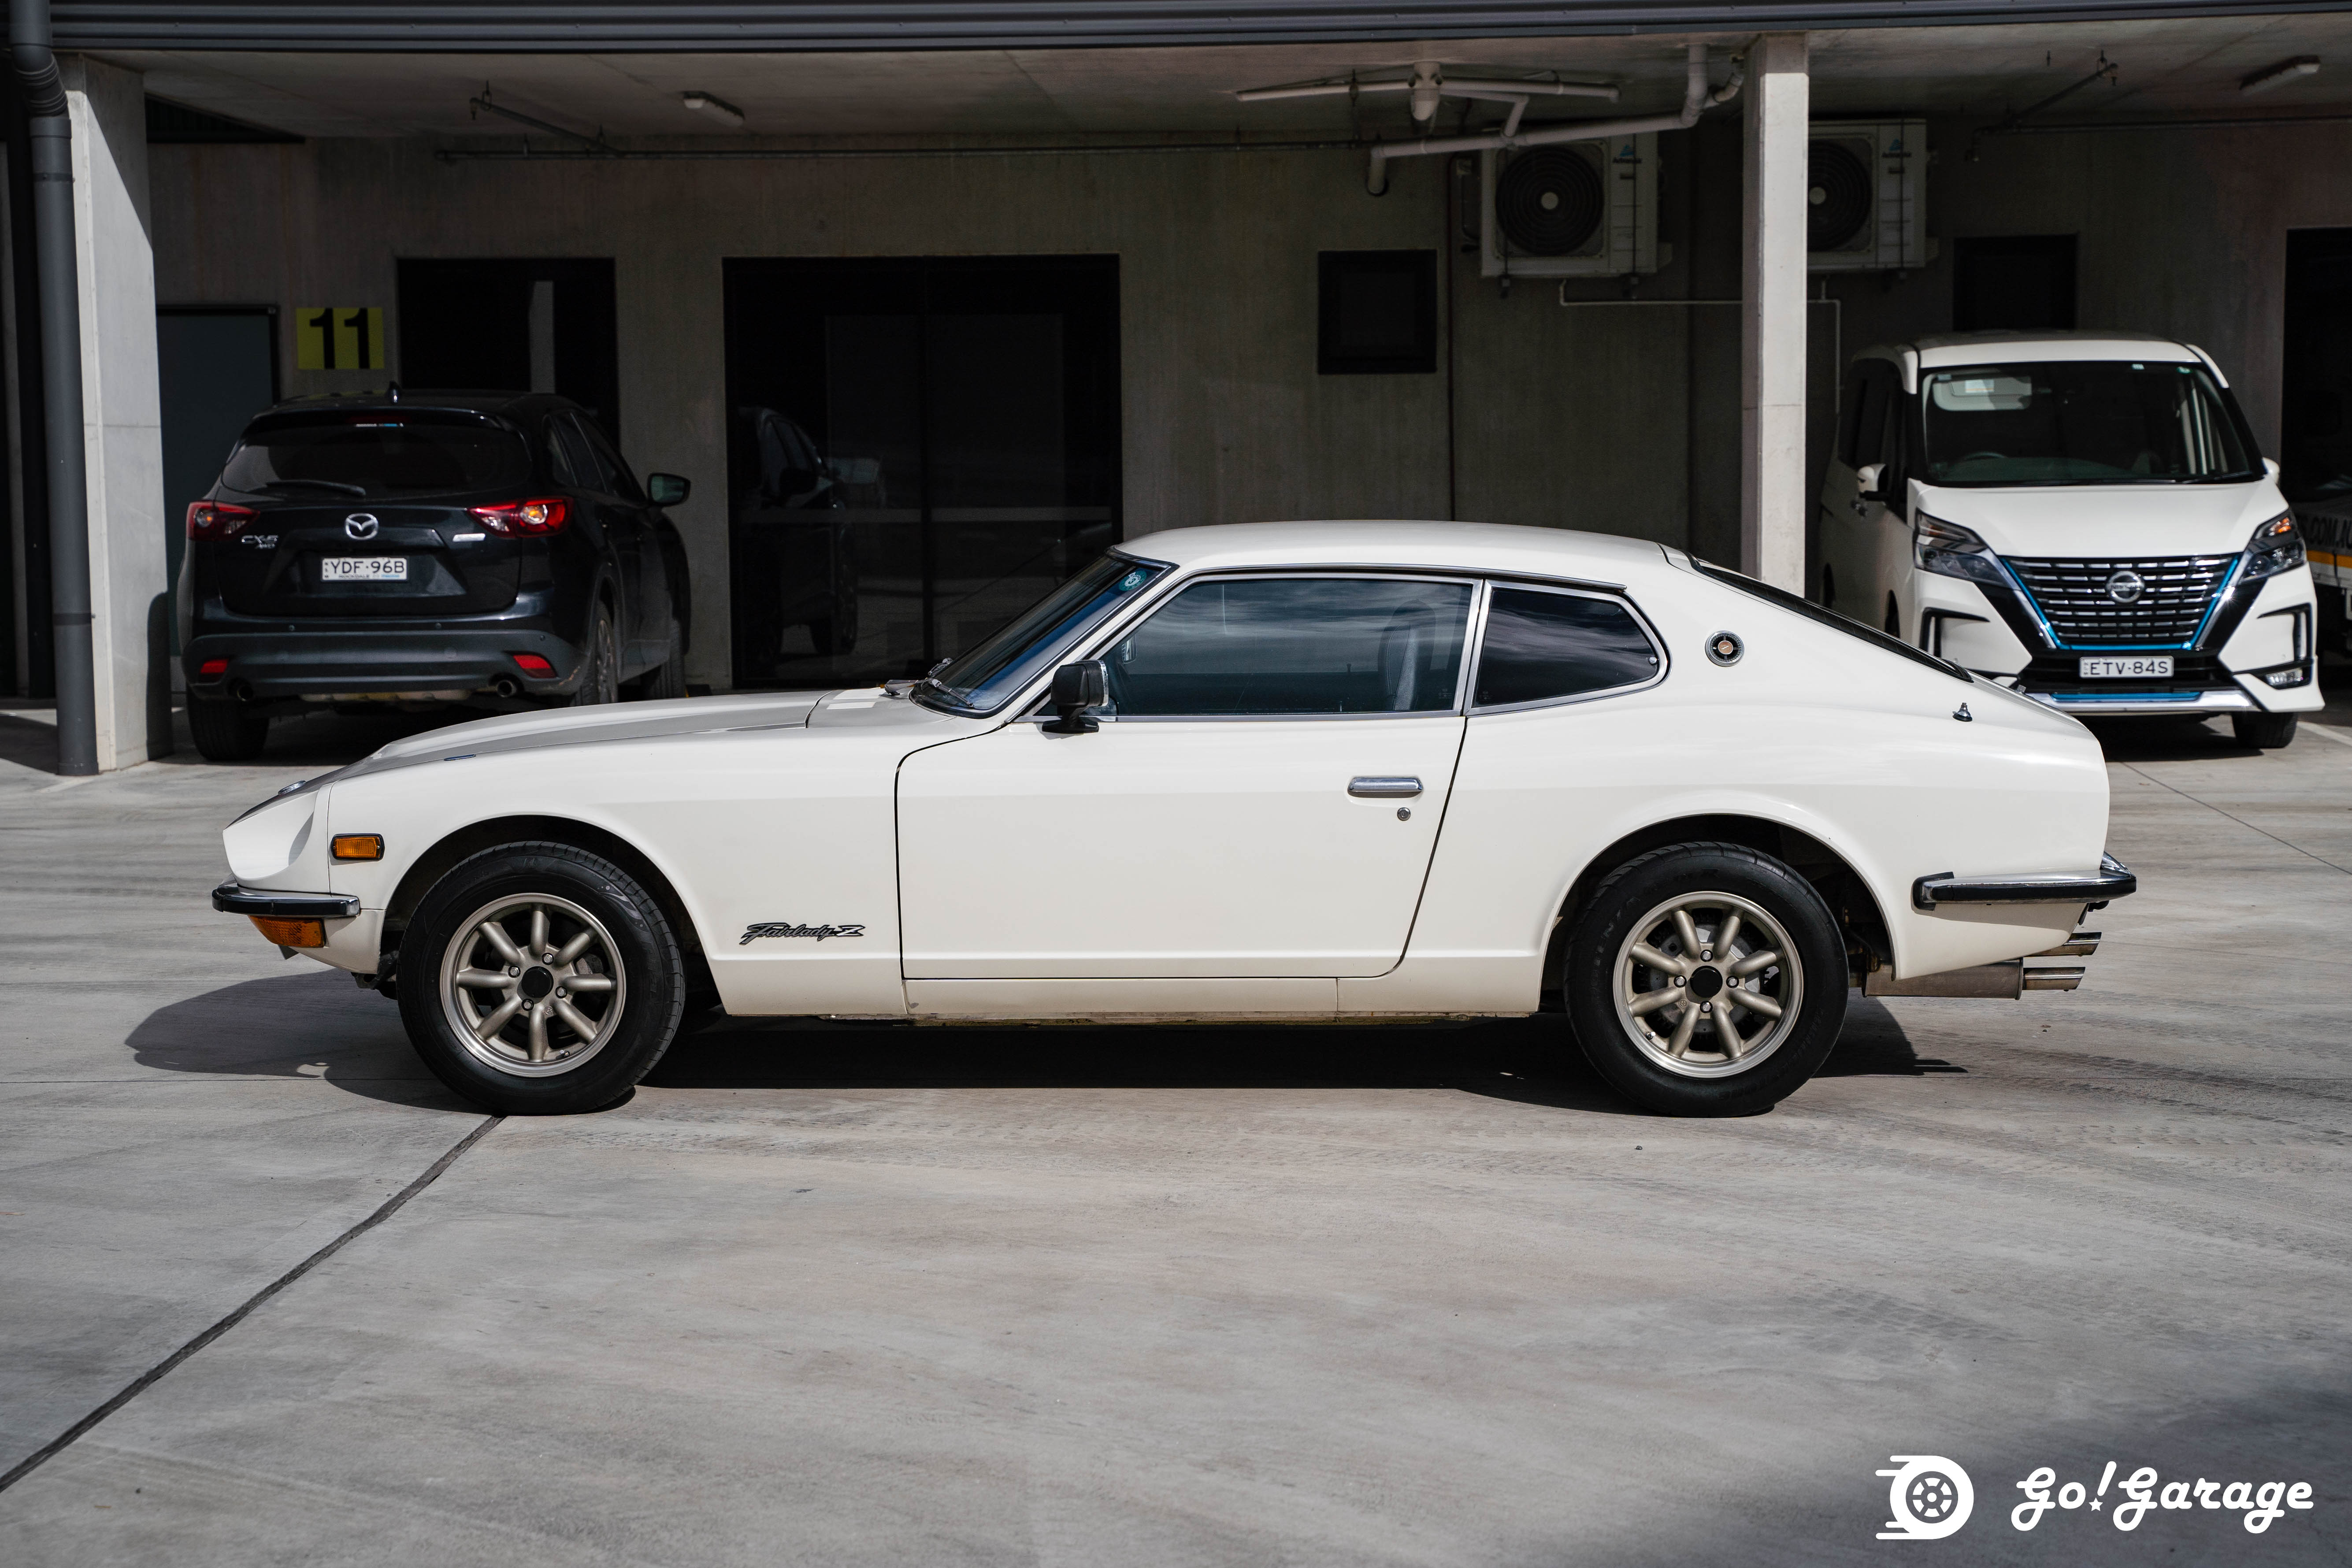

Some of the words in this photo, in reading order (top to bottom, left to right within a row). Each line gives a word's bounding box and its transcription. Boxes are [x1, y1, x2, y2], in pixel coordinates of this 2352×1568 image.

[310, 308, 370, 369] 11
[739, 922, 836, 945] Fairlady
[836, 924, 866, 937] Z
